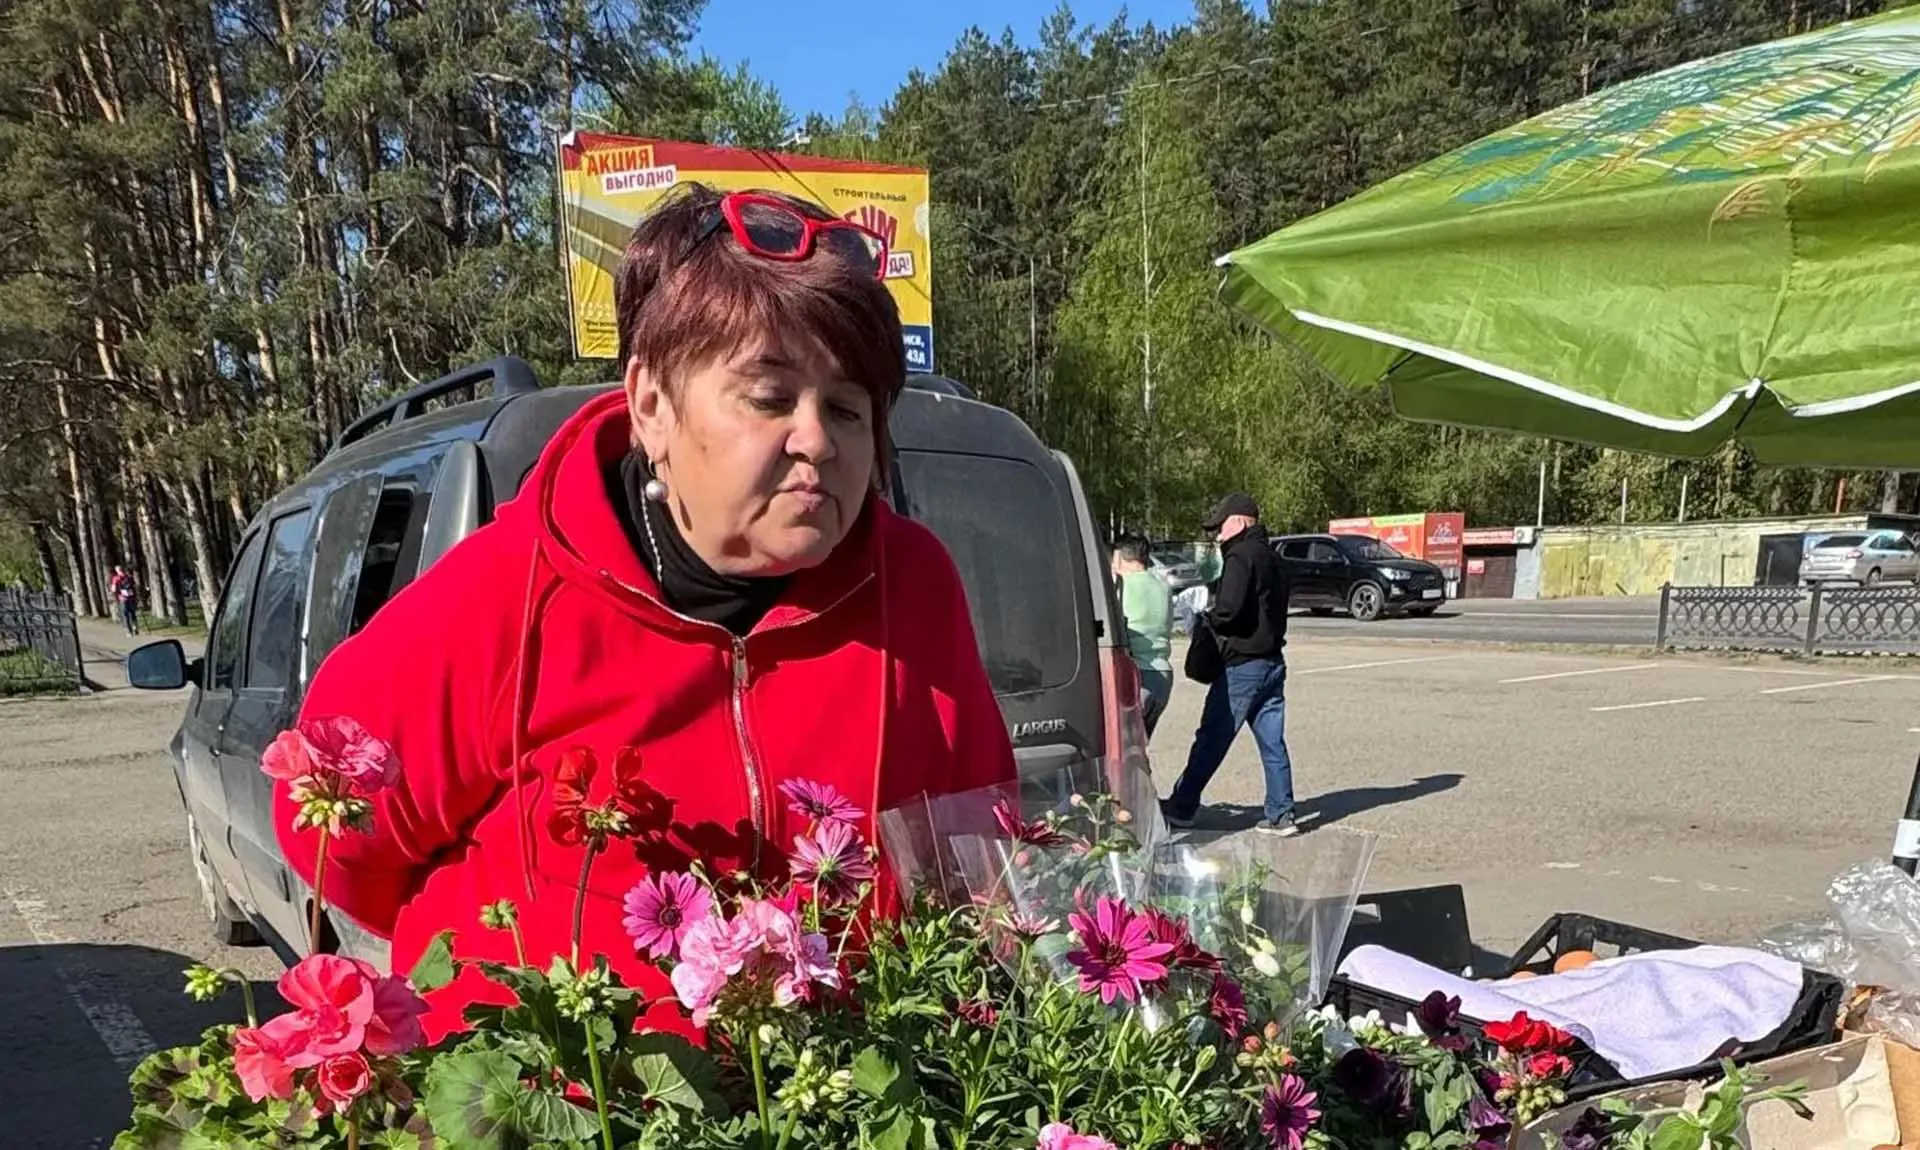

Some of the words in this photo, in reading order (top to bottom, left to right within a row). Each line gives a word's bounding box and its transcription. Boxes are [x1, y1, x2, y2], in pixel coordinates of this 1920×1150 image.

[586, 148, 649, 176] АКЦИЯ
[605, 169, 673, 190] ВЫГОДНО
[1013, 718, 1066, 739] LARGUS
